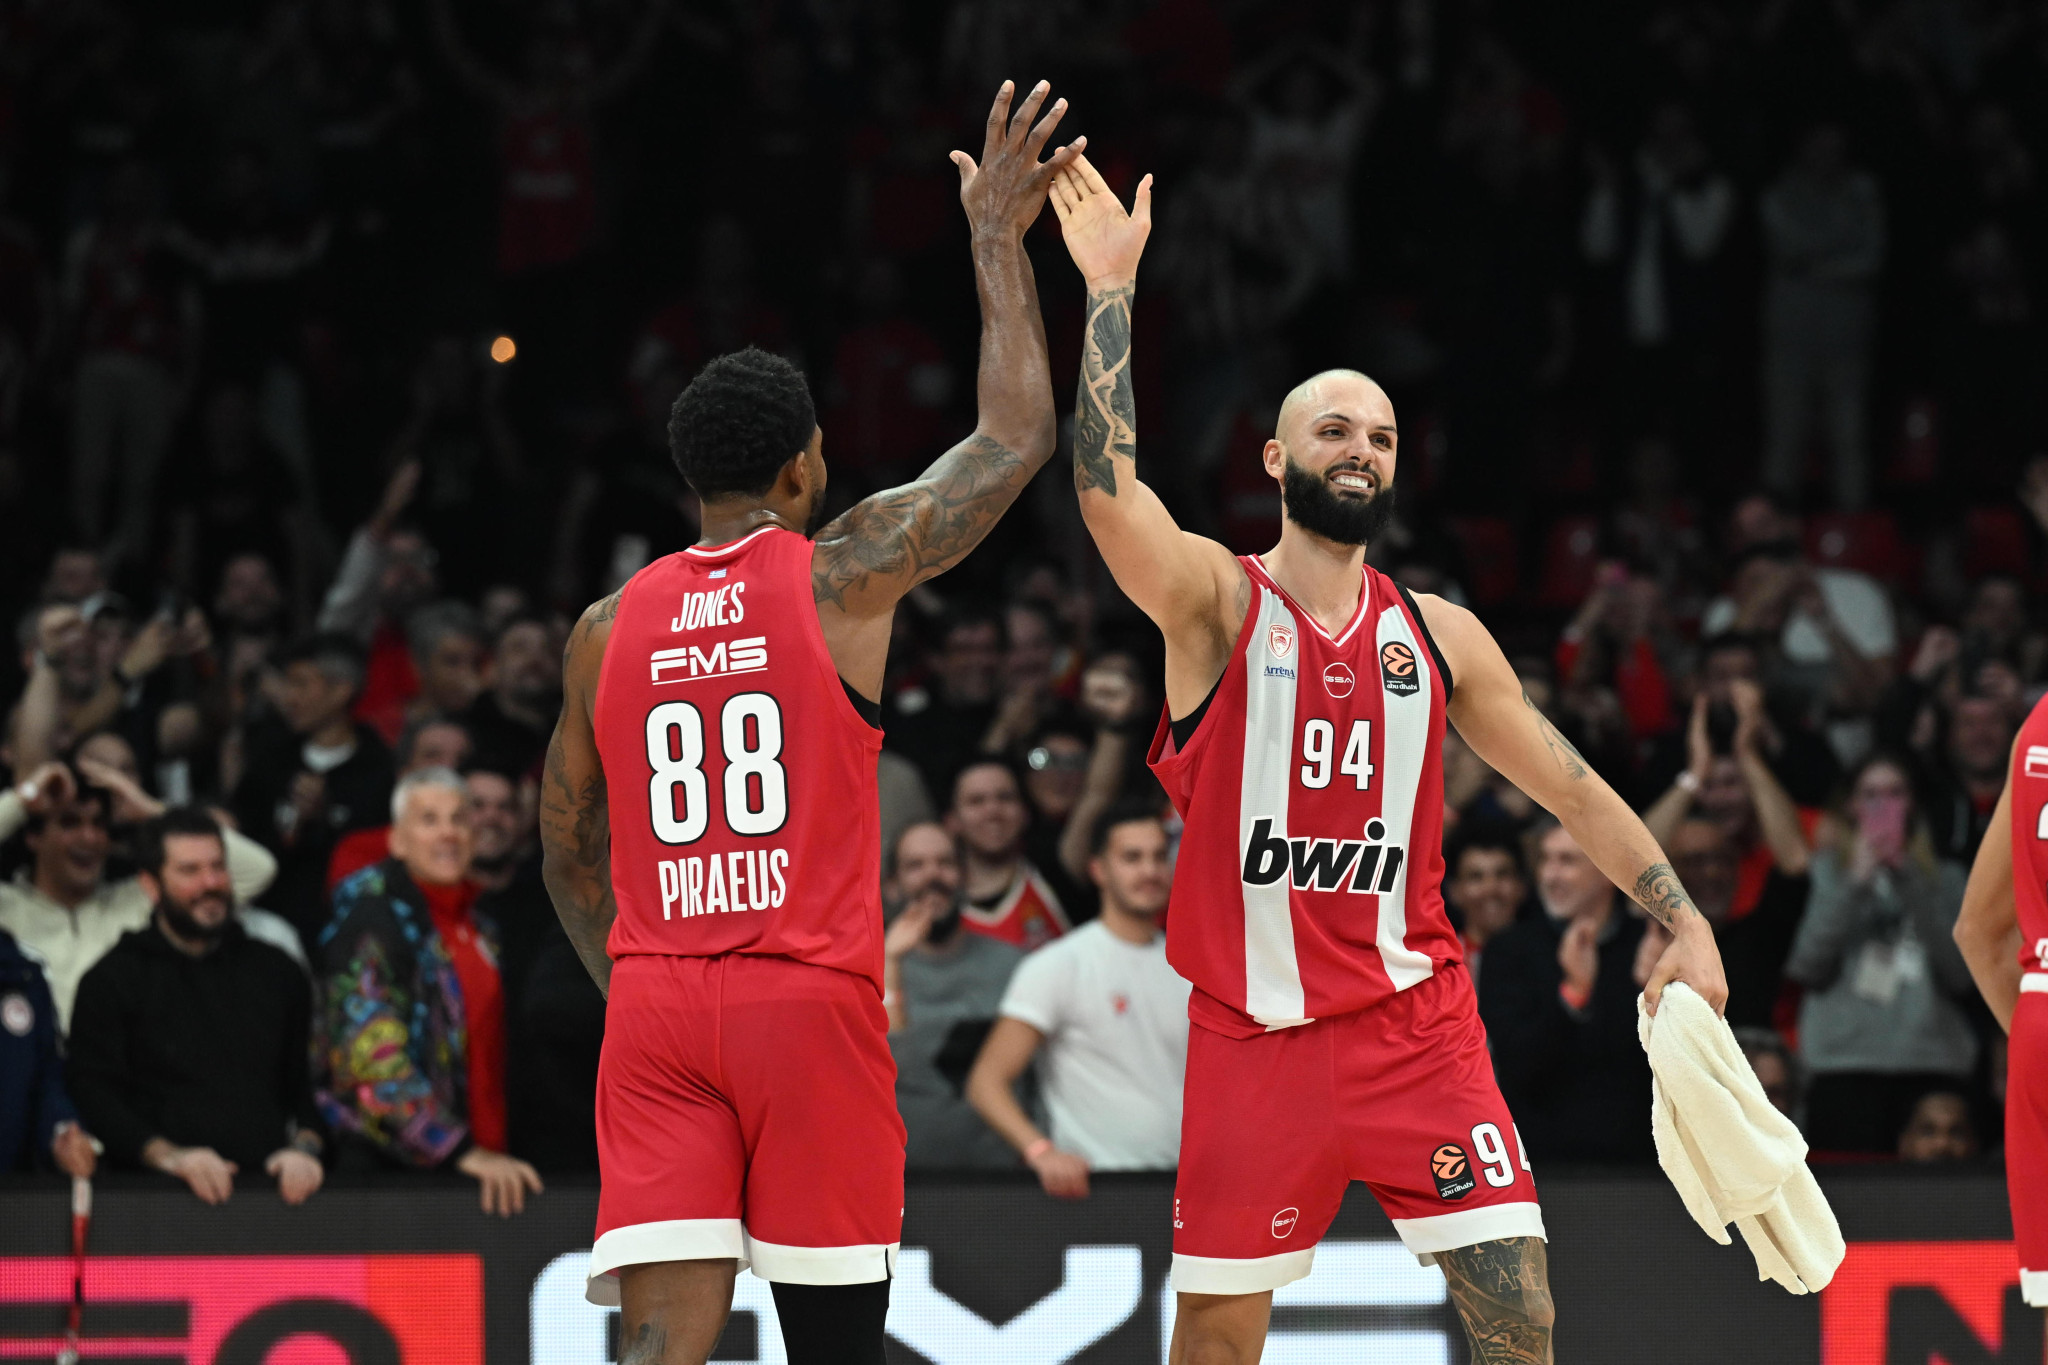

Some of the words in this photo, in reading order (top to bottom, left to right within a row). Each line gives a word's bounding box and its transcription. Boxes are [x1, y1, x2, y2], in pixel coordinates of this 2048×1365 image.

[671, 581, 745, 632] JONES
[650, 636, 768, 683] FMS
[1325, 675, 1353, 684] GSA
[645, 691, 789, 846] 88
[1300, 718, 1375, 791] 94
[658, 848, 789, 921] PIRAEUS
[1470, 1254, 1505, 1273] YOU
[1497, 1263, 1543, 1293] ARE
